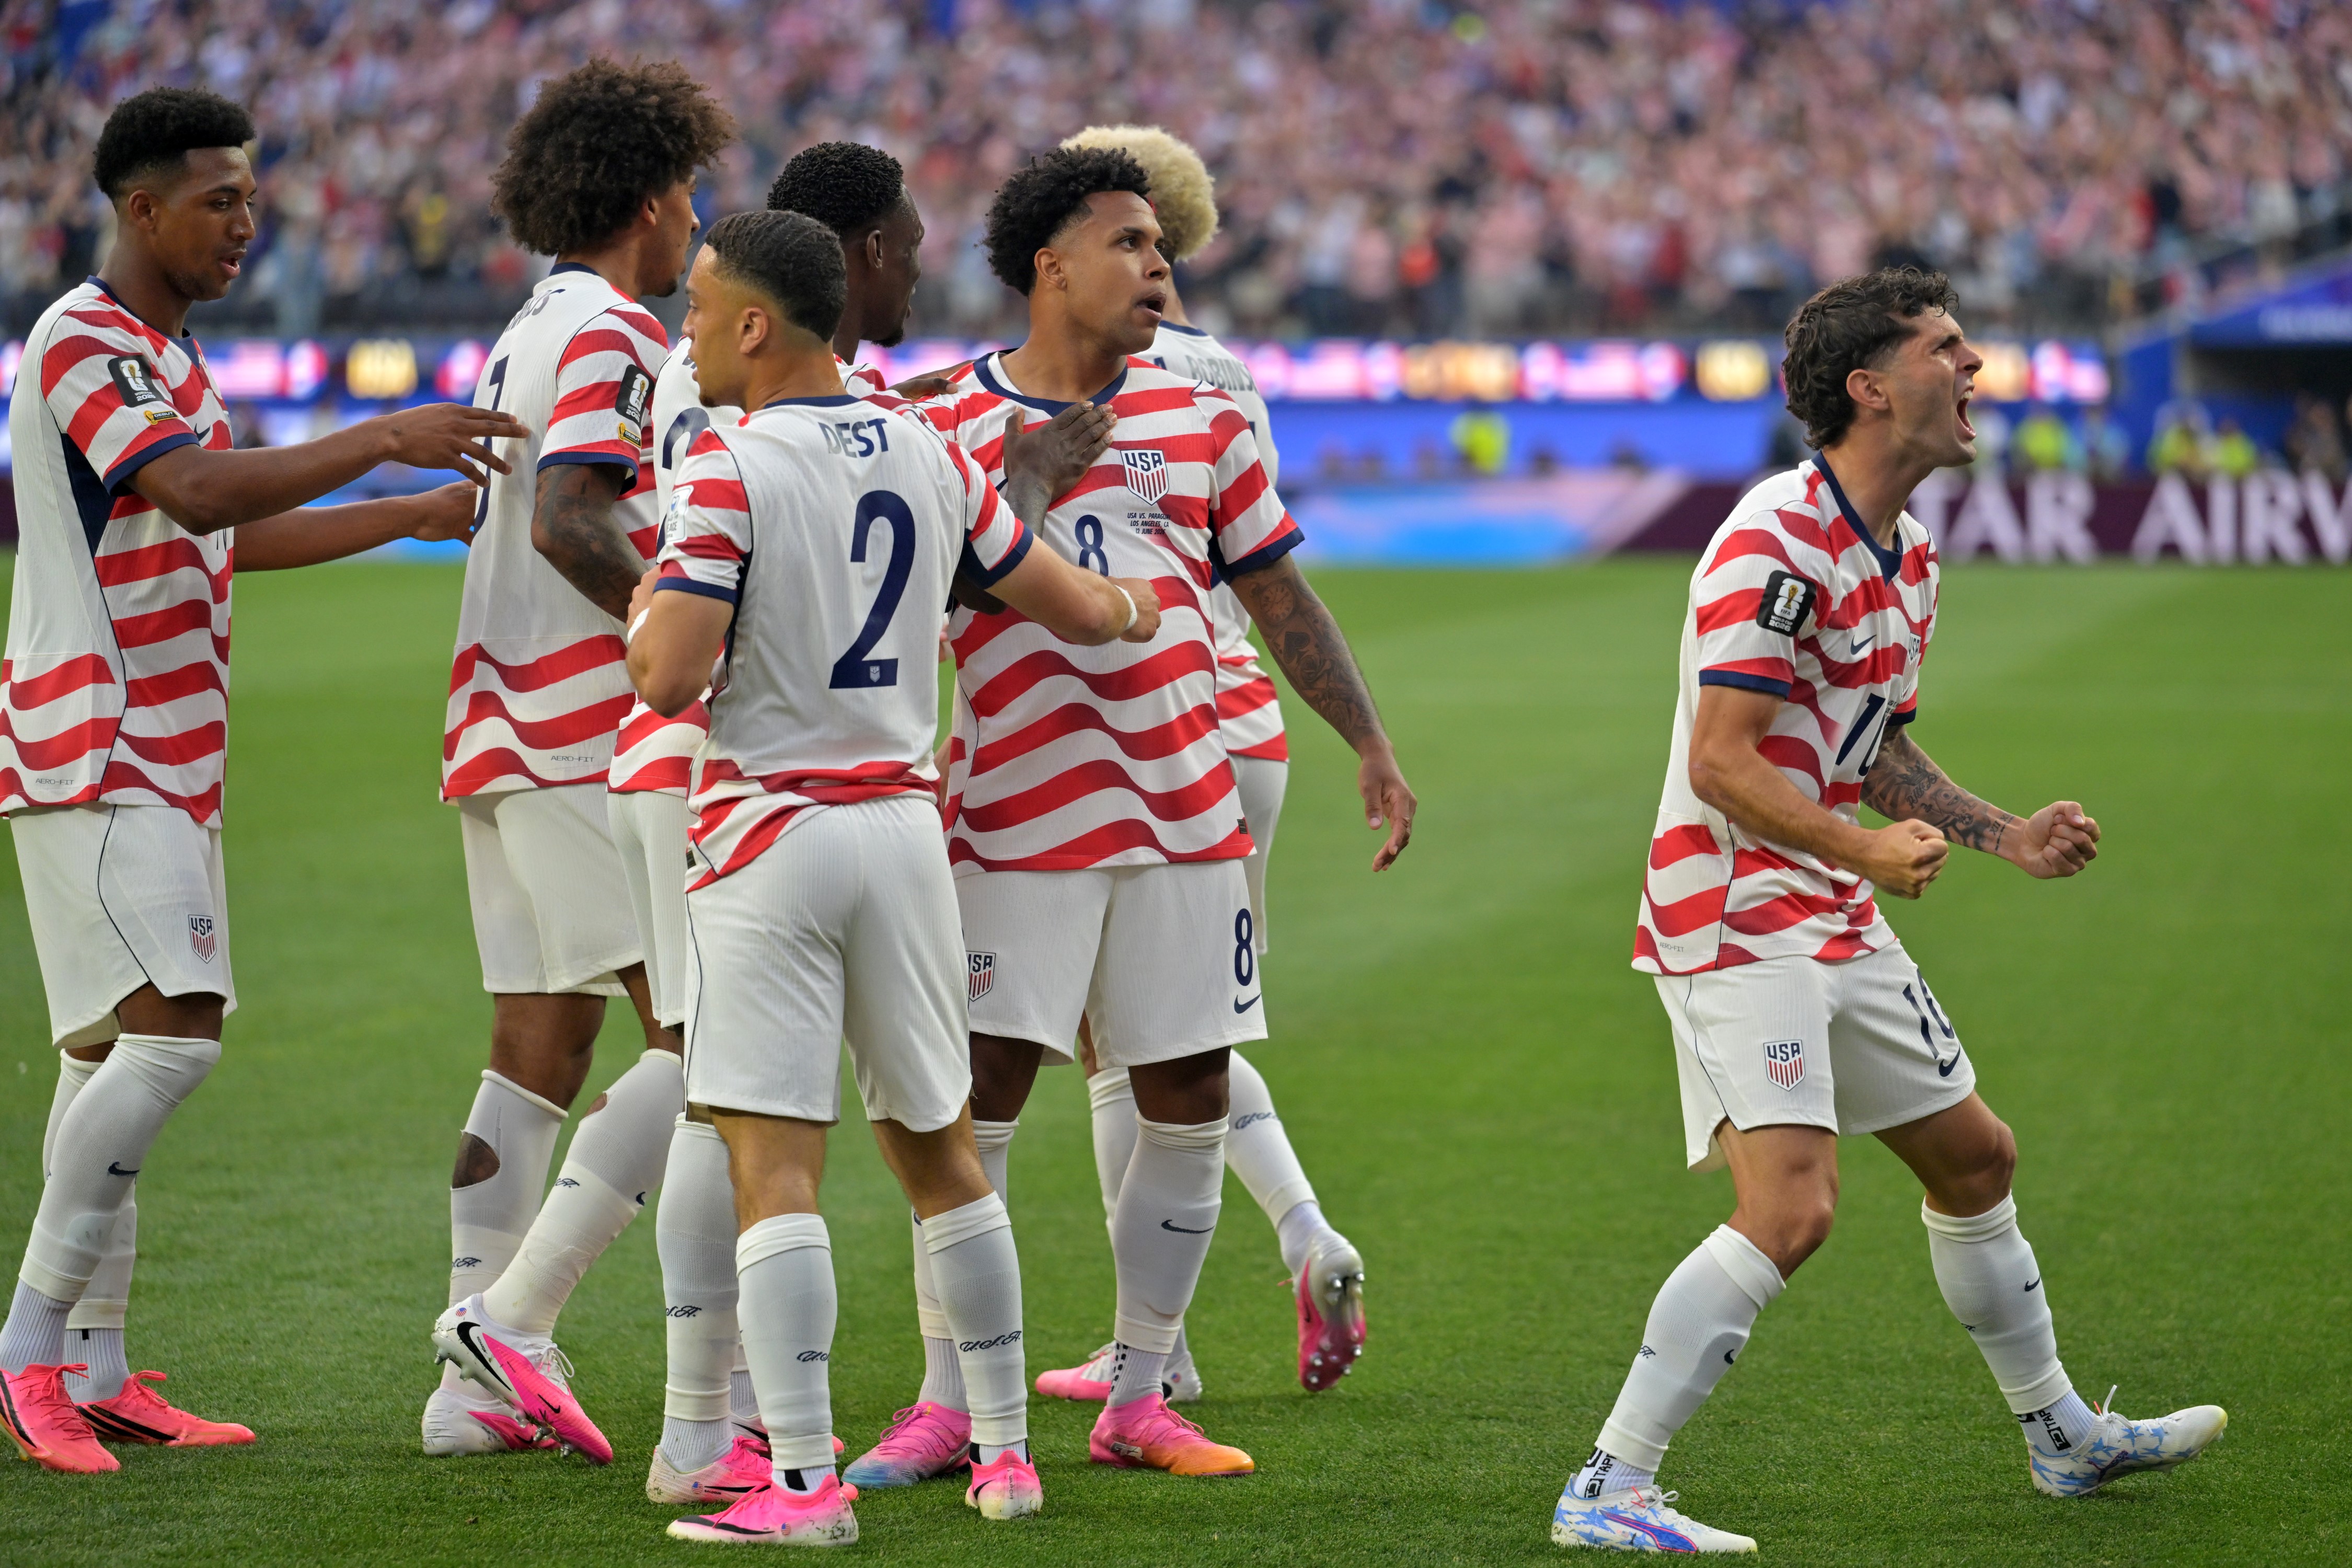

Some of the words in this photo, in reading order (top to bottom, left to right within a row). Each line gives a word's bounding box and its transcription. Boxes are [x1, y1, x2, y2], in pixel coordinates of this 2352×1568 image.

[1185, 355, 1259, 392] ROBINS
[625, 431, 640, 442] DEBUT
[817, 418, 887, 458] DEST
[1124, 452, 1163, 472] USA
[828, 490, 916, 689] 2
[1768, 619, 1791, 632] 2026
[1771, 615, 1785, 623] WORLD
[1908, 636, 1920, 661] USA
[190, 917, 213, 936] USA
[1234, 908, 1253, 986] 8
[1659, 941, 1685, 953] AERO-FIT
[1767, 1042, 1800, 1062] USA
[960, 1331, 1022, 1352] U.S.A.
